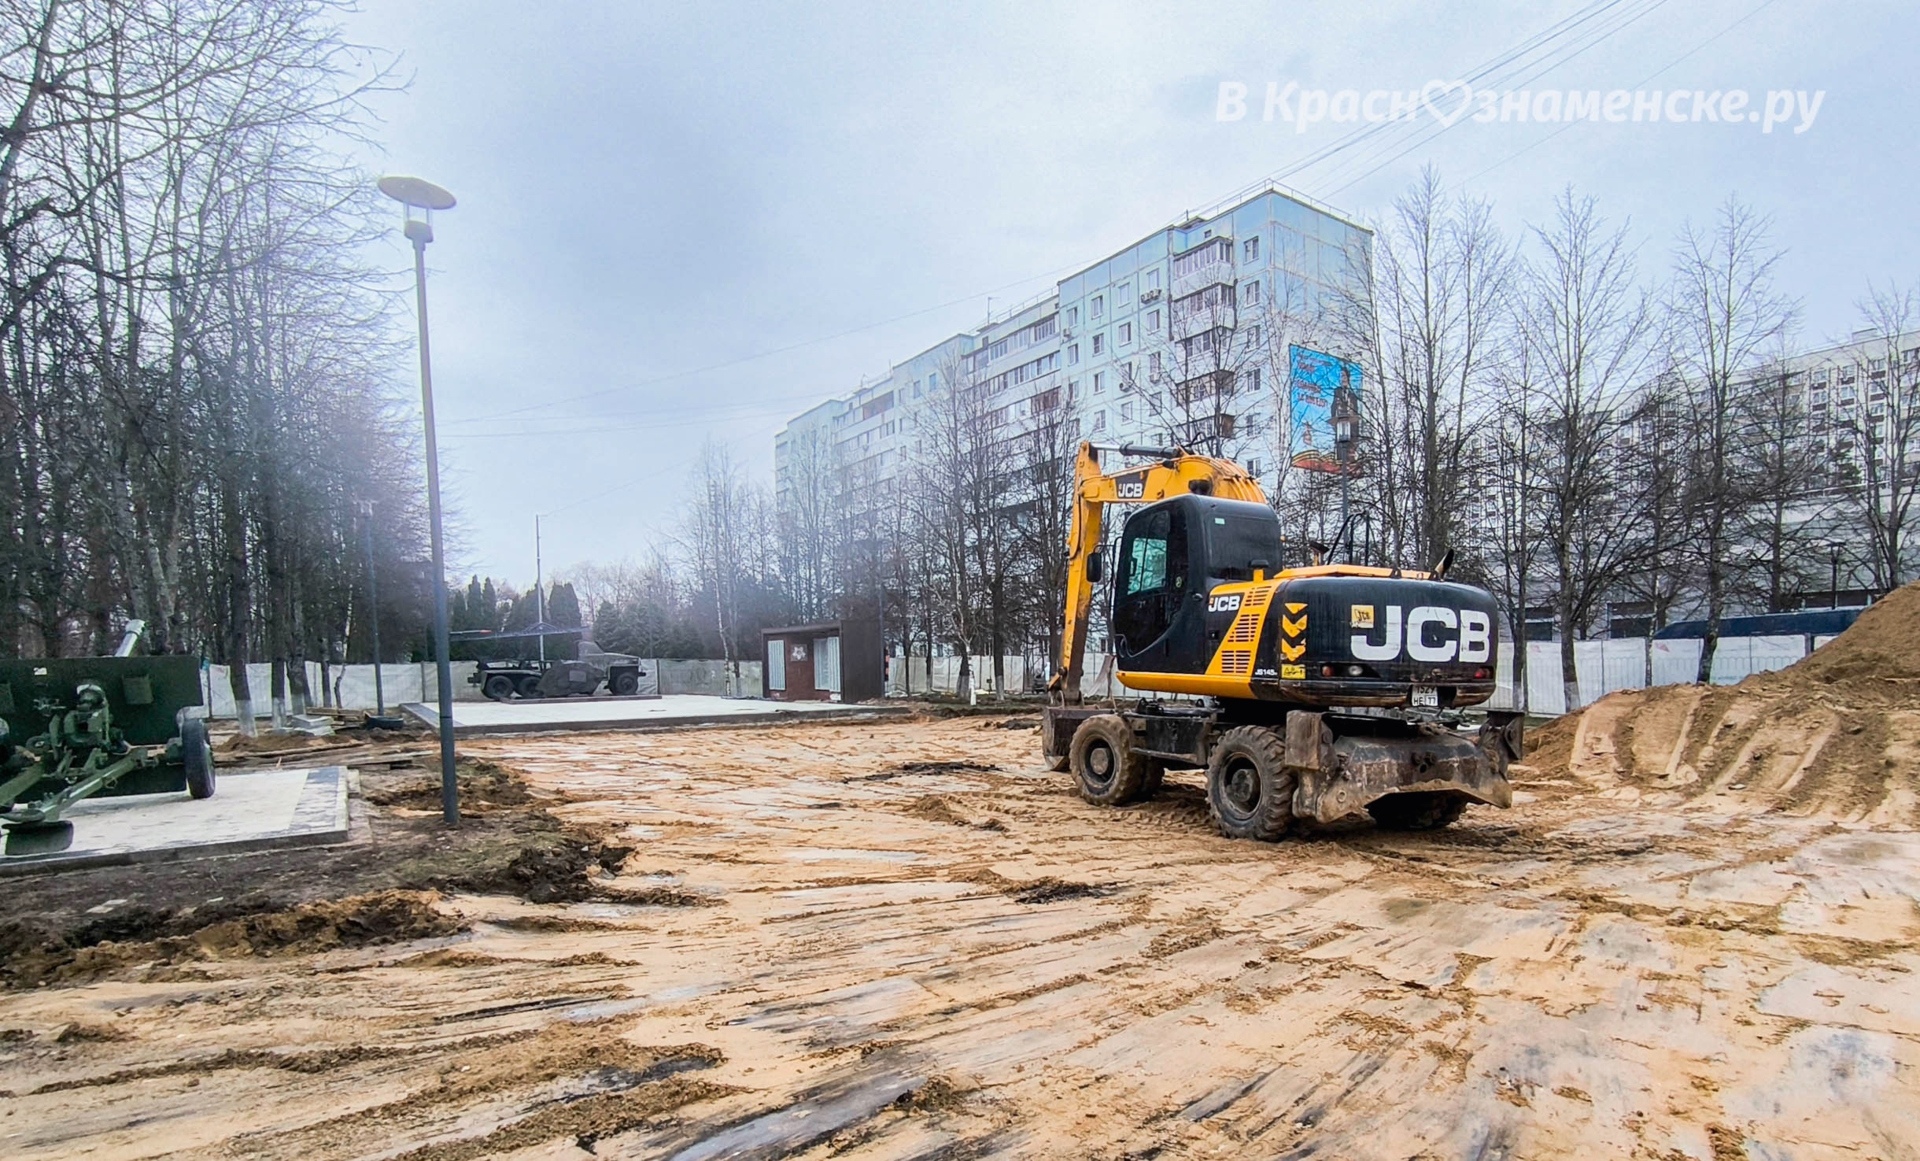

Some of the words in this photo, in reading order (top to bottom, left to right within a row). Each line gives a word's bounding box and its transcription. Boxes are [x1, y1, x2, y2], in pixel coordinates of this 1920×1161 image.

[1118, 483, 1143, 498] JCB
[1208, 595, 1241, 613] JCB
[1350, 605, 1490, 663] JCB
